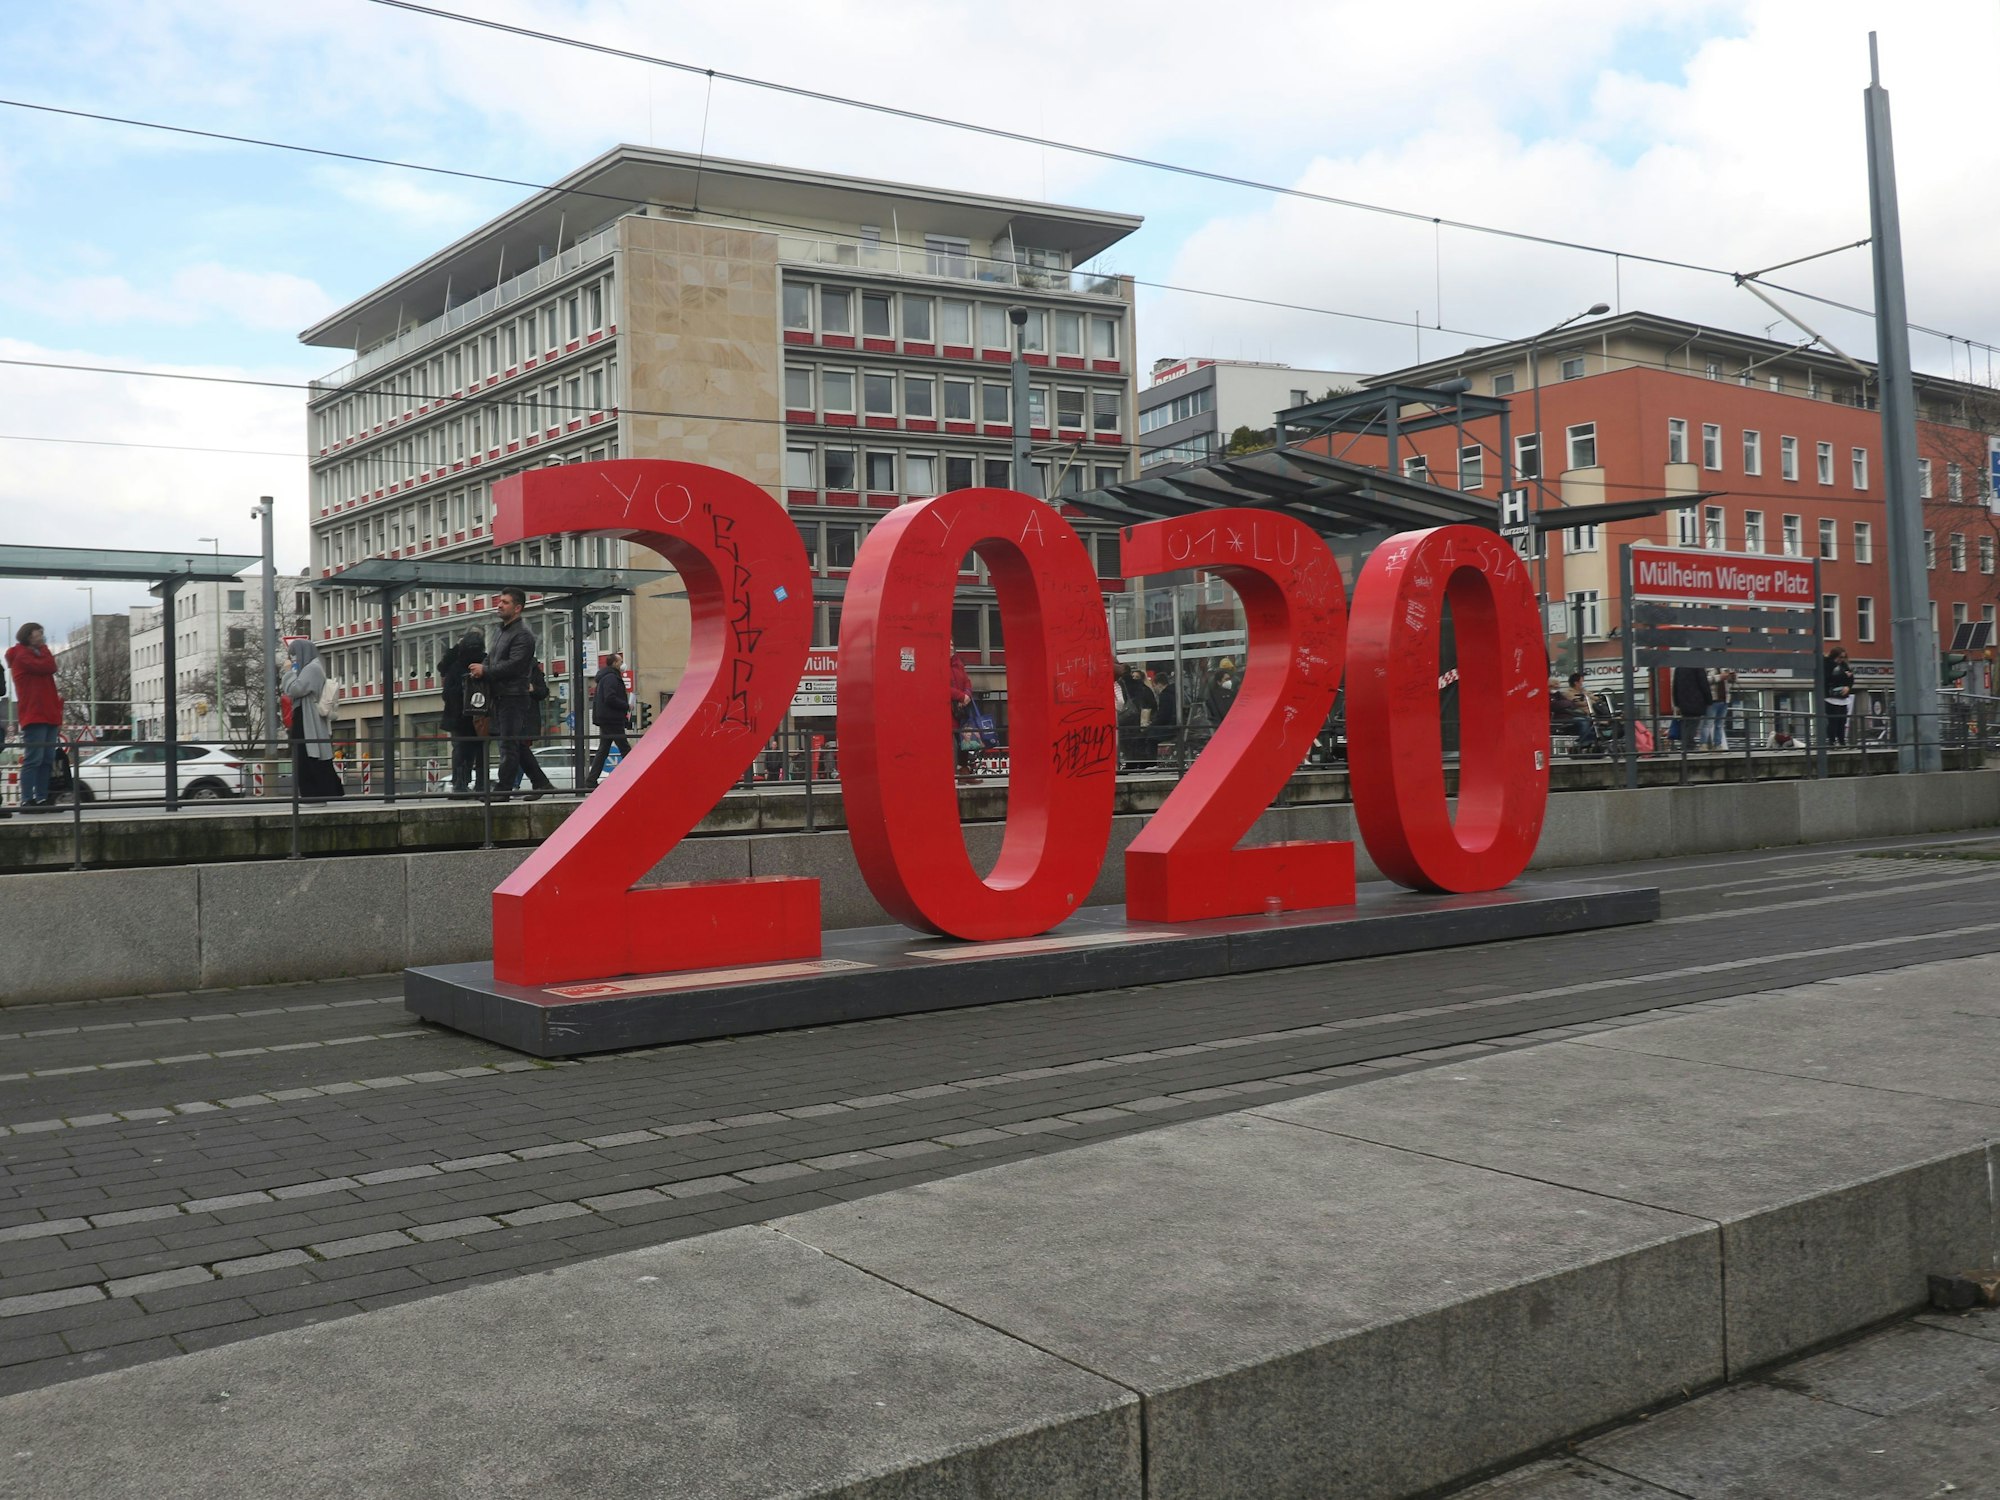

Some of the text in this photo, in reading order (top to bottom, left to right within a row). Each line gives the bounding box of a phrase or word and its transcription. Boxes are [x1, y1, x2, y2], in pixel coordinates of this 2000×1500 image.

[1502, 490, 1524, 525] H
[1500, 525, 1529, 536] Kurzzug
[1519, 536, 1528, 554] 4
[1639, 560, 1809, 595] Mülheim Wiener Platz
[804, 656, 837, 671] Mülh
[493, 459, 1551, 987] 2020
